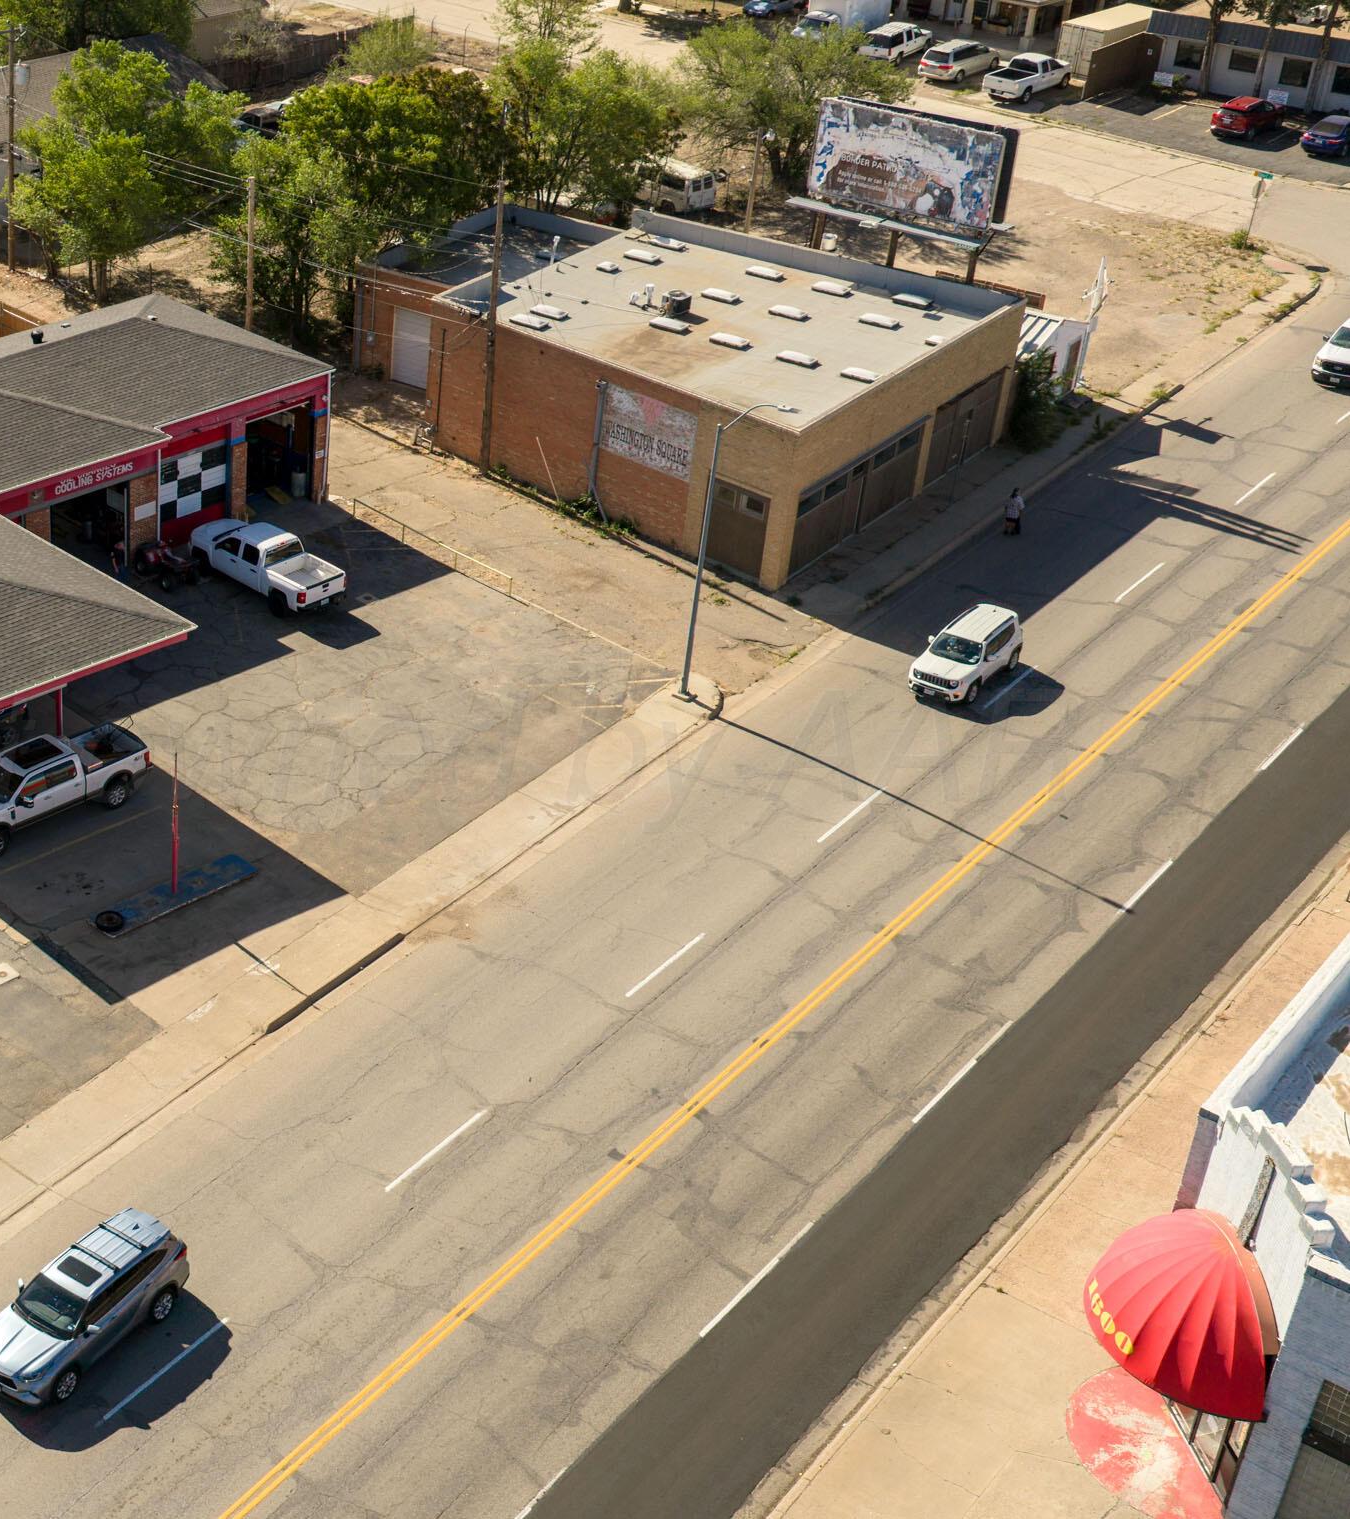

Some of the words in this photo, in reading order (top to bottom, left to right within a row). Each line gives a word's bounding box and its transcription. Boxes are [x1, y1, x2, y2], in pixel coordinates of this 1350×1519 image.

[656, 440, 689, 467] SQUARE
[55, 475, 93, 495] COOLING
[95, 462, 134, 481] SYSTEMS
[1088, 1278, 1134, 1355] 1600
